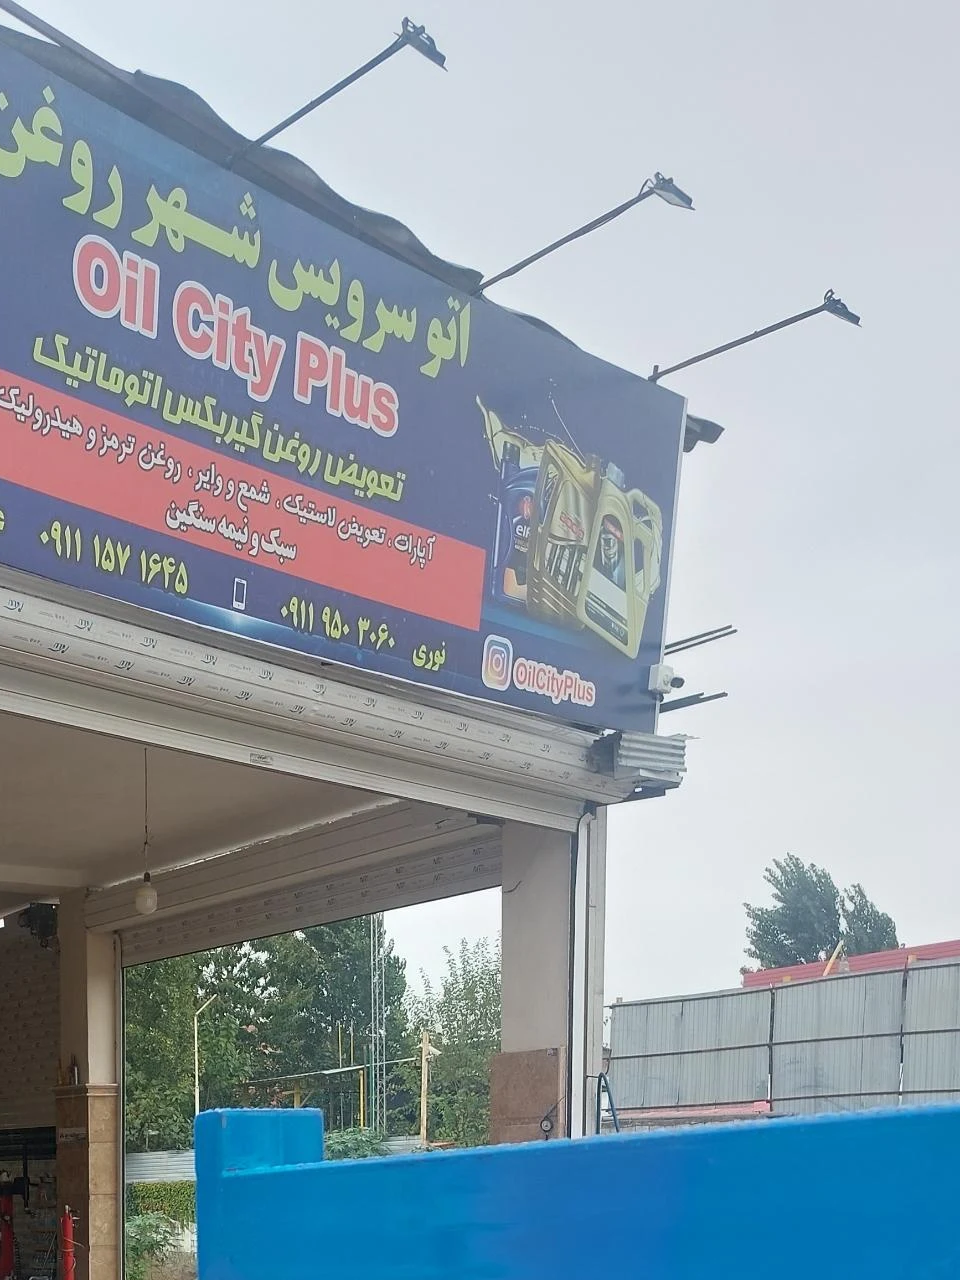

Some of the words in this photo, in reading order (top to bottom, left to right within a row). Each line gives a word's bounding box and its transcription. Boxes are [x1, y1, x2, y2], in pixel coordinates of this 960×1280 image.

[131, 184, 261, 268] شهر
[268, 258, 417, 353] سرویس
[72, 234, 160, 339] Oil
[172, 280, 287, 401] City
[294, 331, 400, 438] Plus
[420, 297, 471, 378] اتو
[32, 334, 161, 409] اتوماتیک
[86, 426, 97, 449] و
[99, 422, 137, 463] ترمز
[162, 387, 262, 456] گیربکس
[138, 442, 182, 481] روغن
[262, 421, 321, 475] روغن
[226, 481, 236, 500] و
[237, 479, 272, 511] شمع
[324, 452, 406, 501] تعویض
[165, 501, 216, 535] سنگین
[215, 516, 249, 551] نیمه
[337, 516, 385, 549] تعویض
[39, 519, 82, 562] ۰۹۱۱
[93, 534, 131, 575] ۱۵۷
[139, 547, 189, 594] ۱۶۴۵
[249, 533, 260, 556] و
[259, 527, 297, 562] سبک
[280, 595, 315, 633] ۰۹۱۱
[321, 604, 351, 639] ۹۵۰
[412, 641, 448, 671] نوری
[513, 657, 595, 706] OilCityPlus
